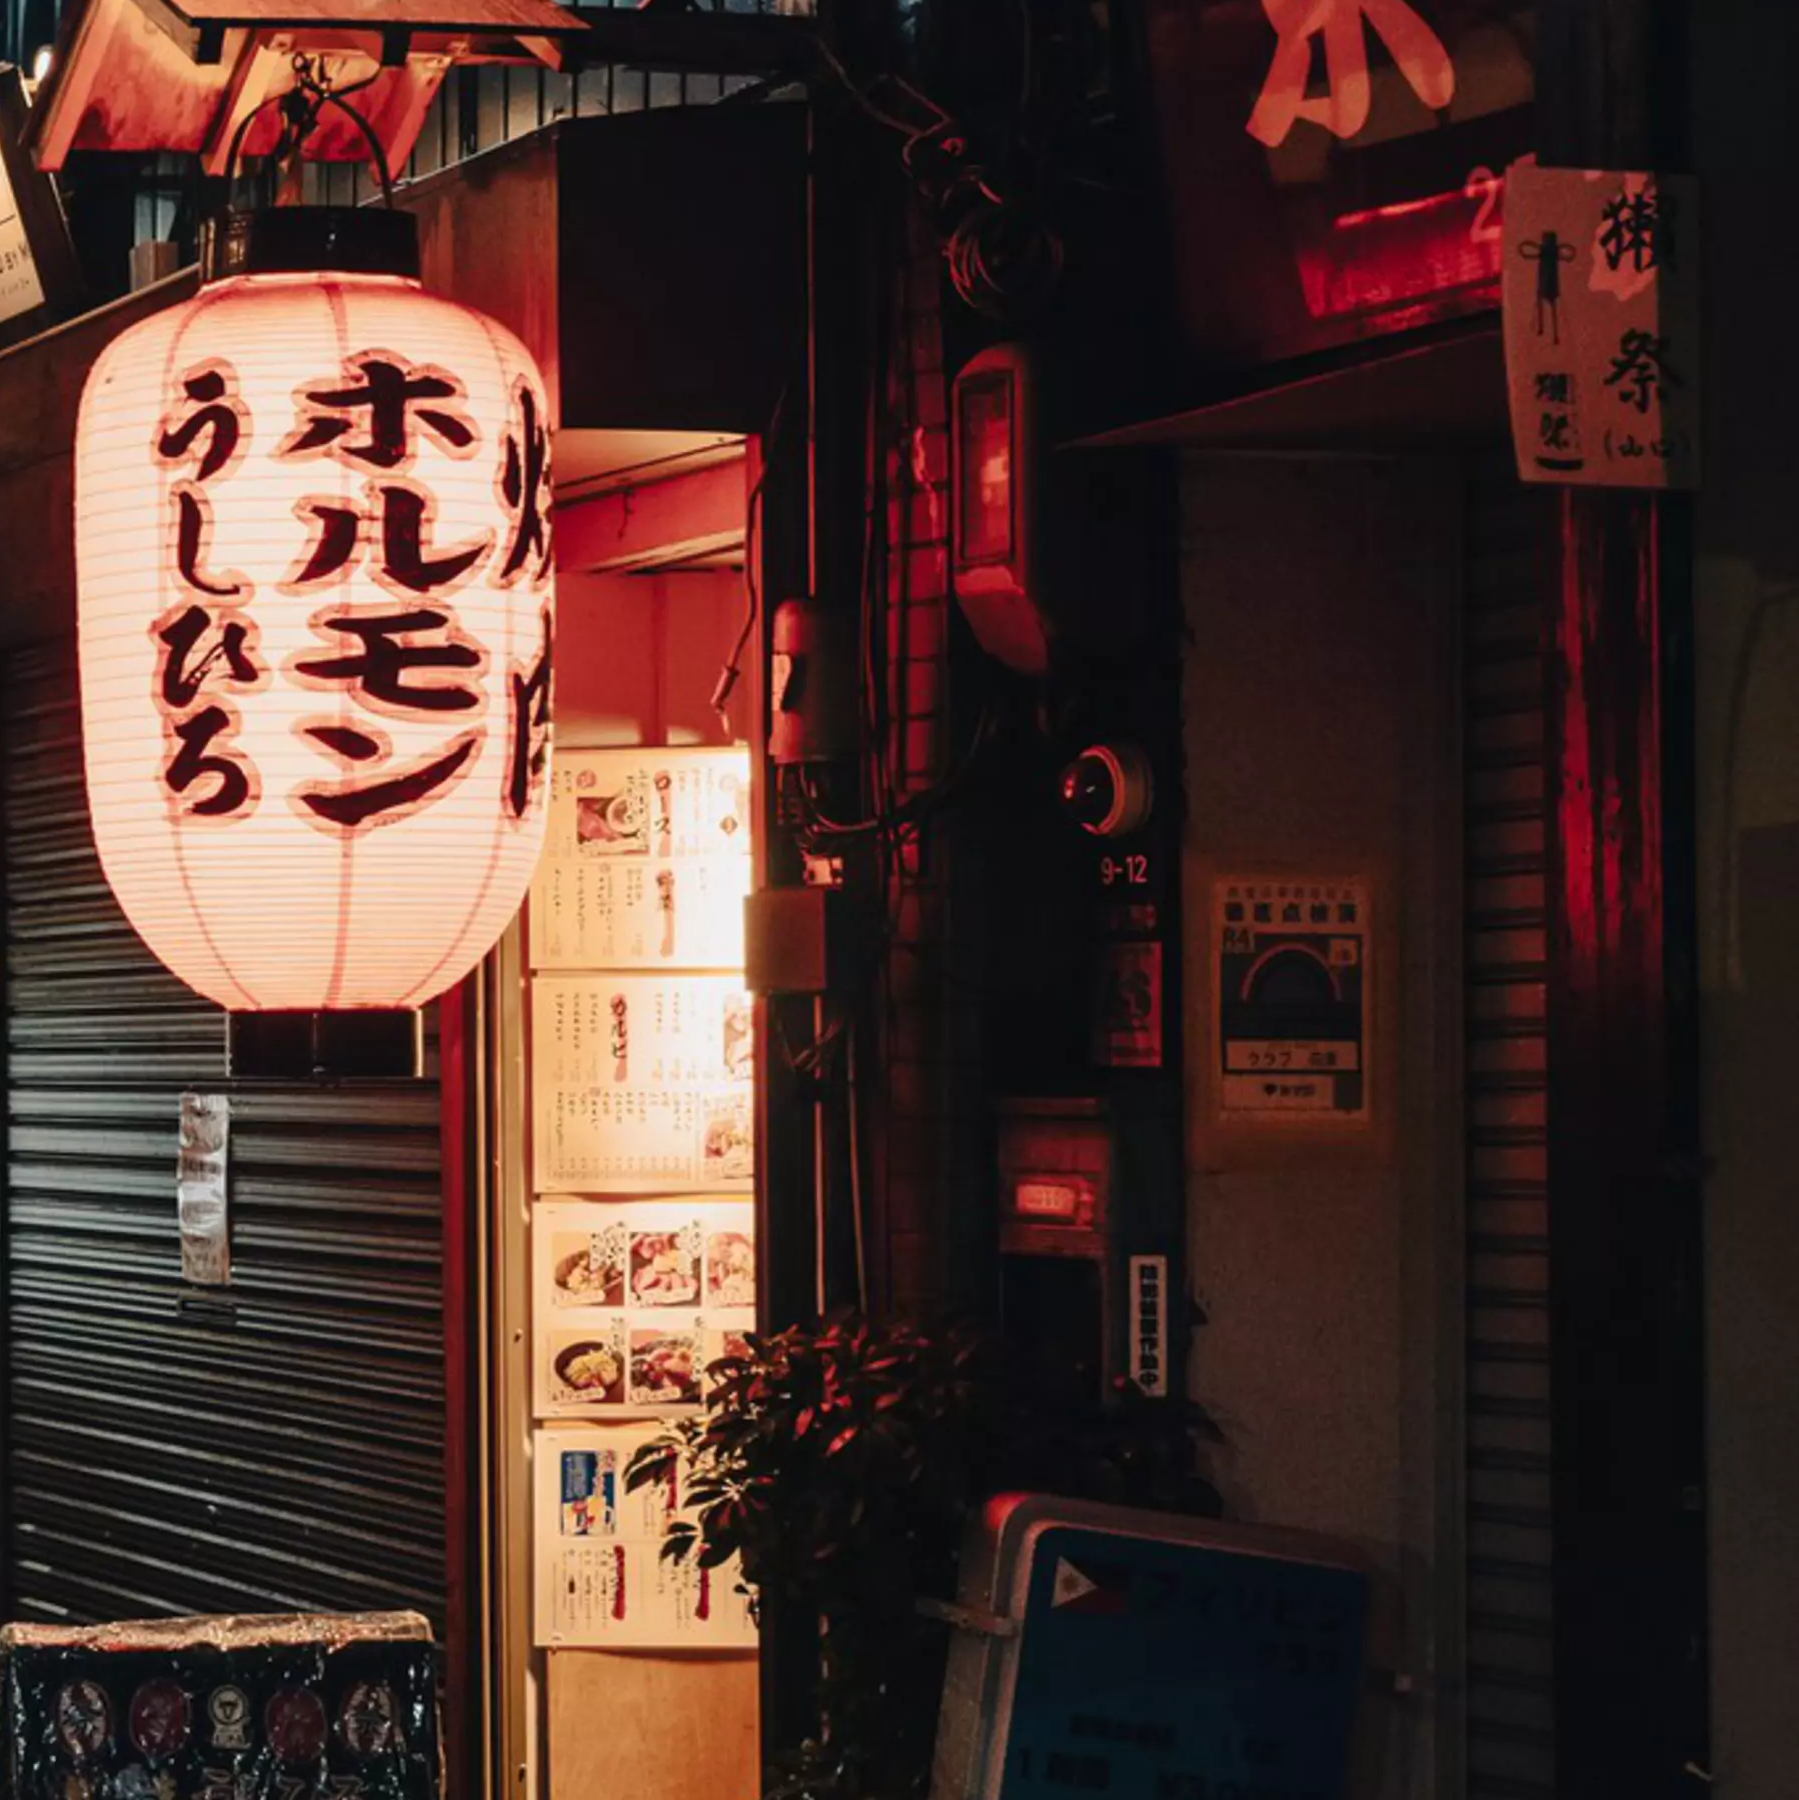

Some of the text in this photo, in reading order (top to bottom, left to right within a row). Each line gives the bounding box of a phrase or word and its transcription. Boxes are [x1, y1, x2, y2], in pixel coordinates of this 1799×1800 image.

[159, 370, 258, 814] うしひろ
[279, 360, 491, 827] ホルモン
[1100, 854, 1149, 885] 9-12
